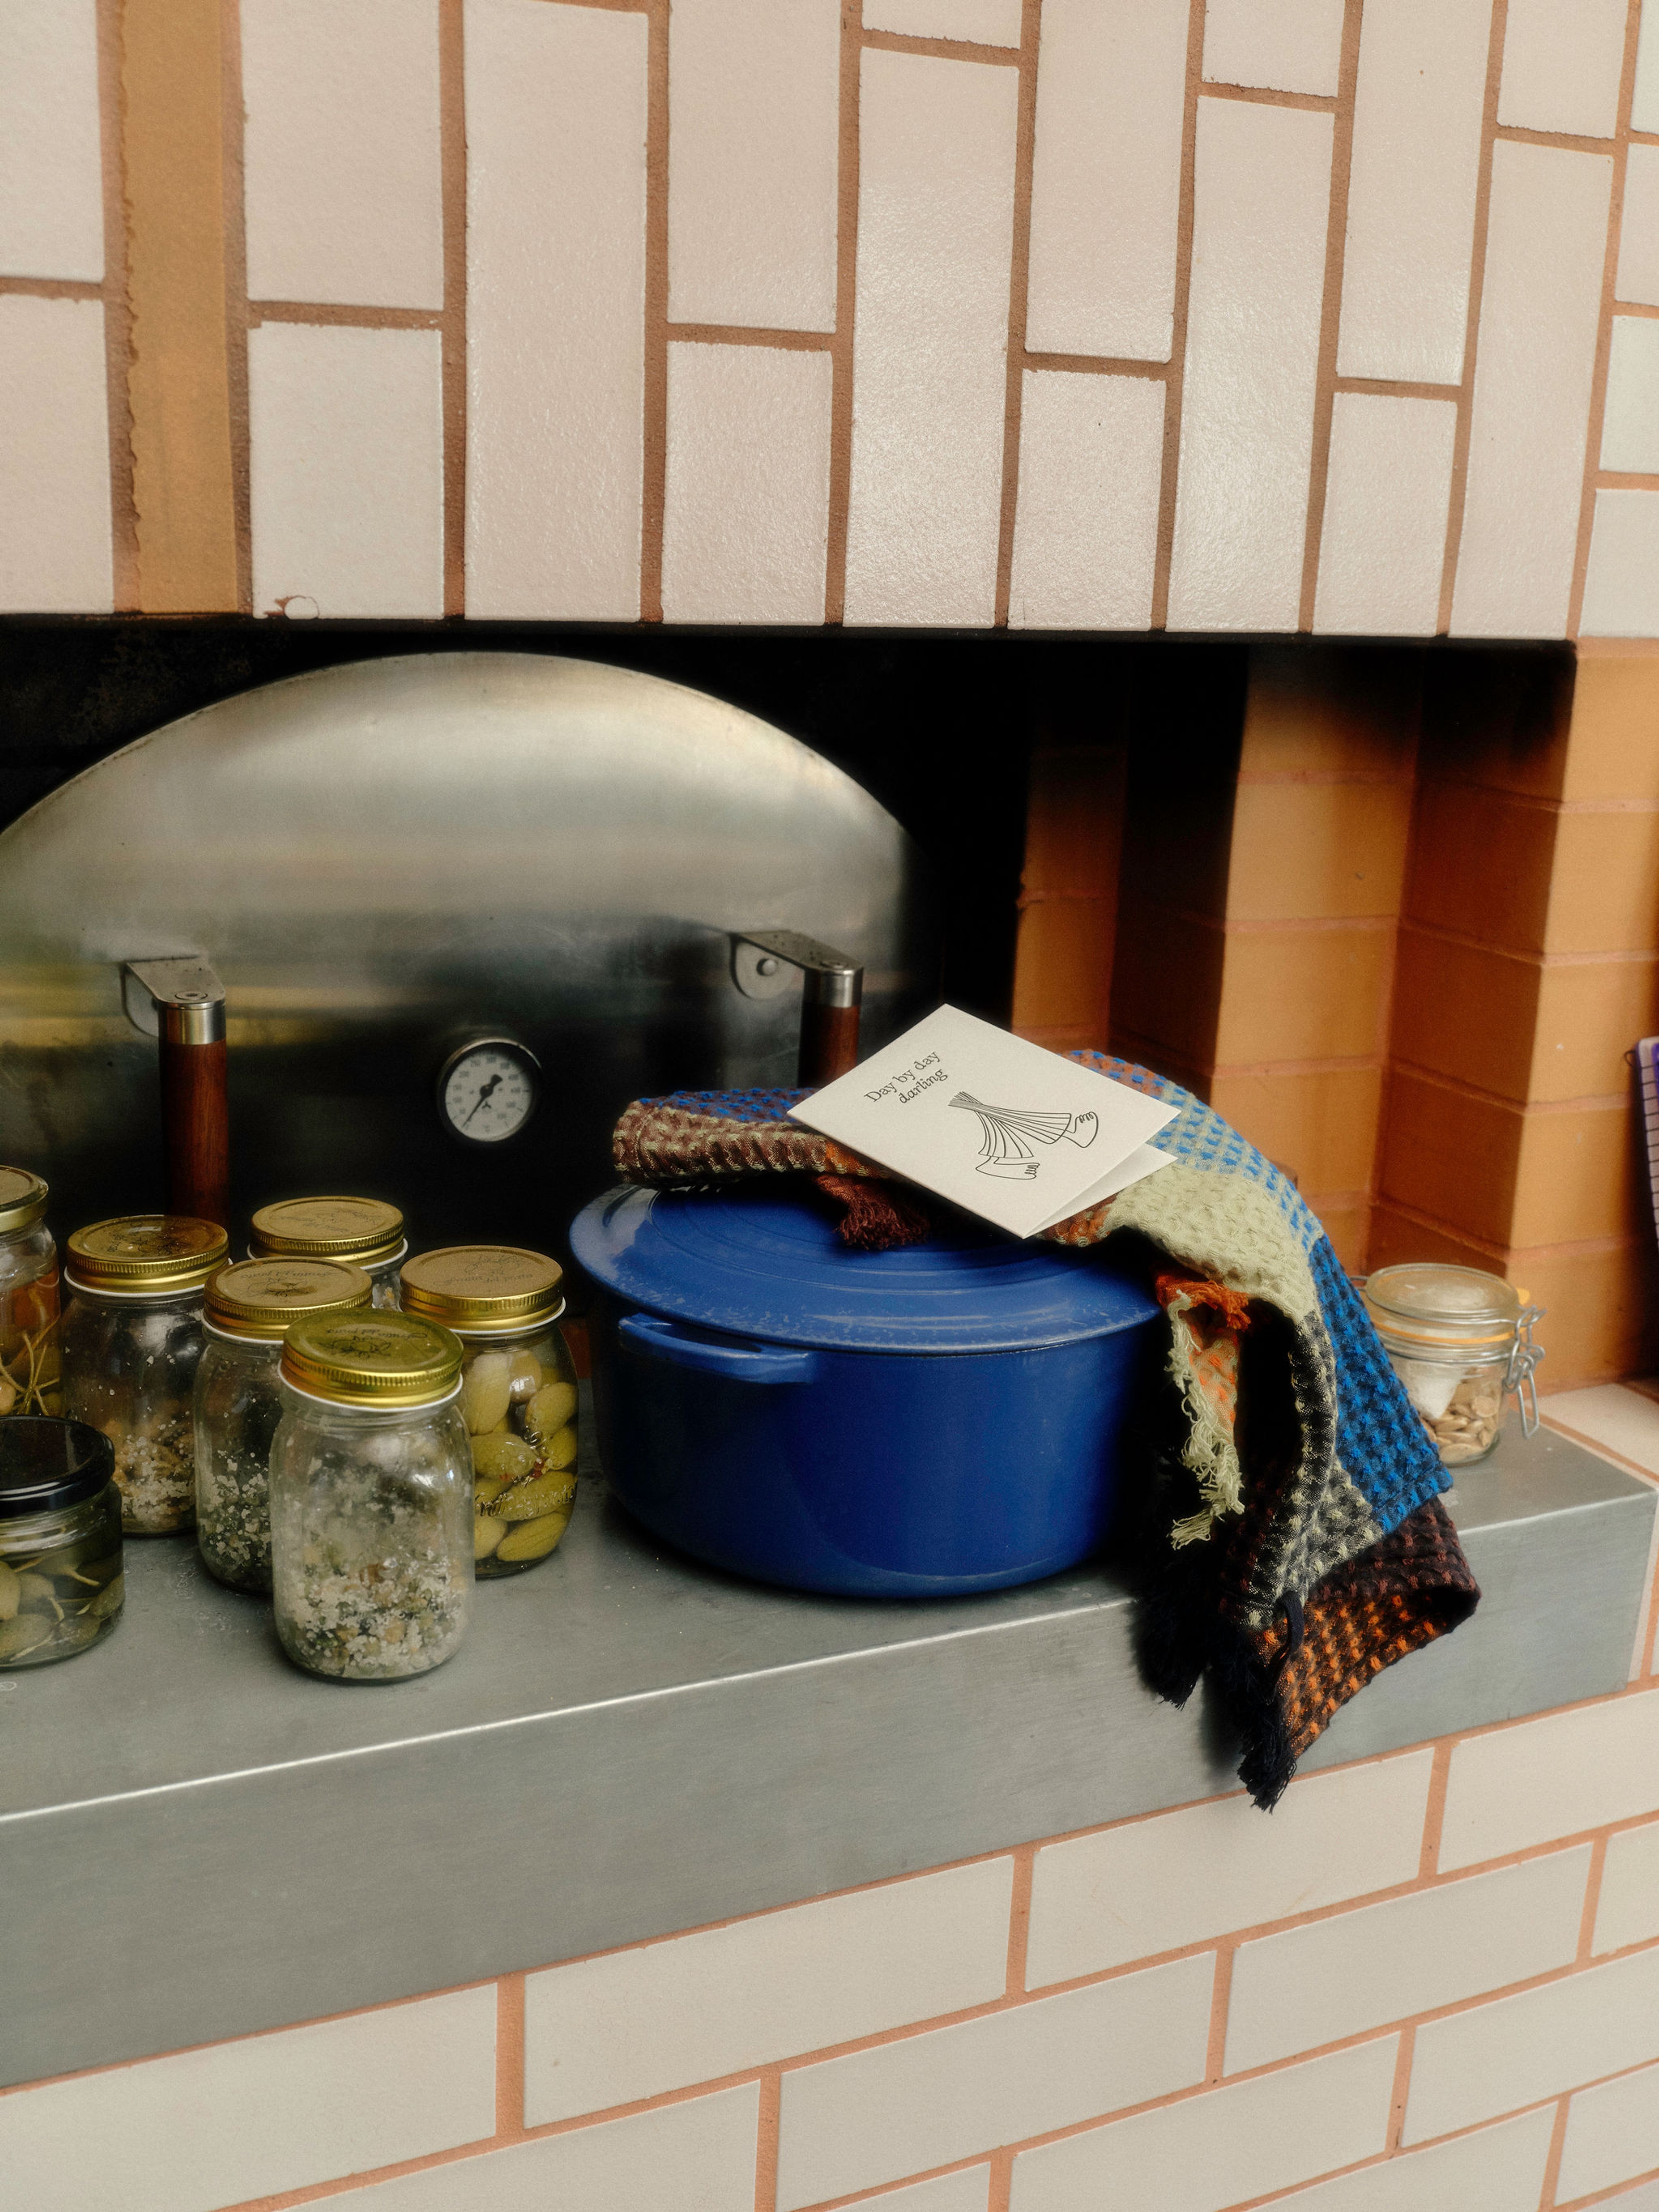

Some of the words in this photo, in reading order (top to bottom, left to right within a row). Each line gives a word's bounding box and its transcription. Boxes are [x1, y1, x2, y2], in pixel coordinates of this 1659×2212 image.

[864, 1082, 897, 1102] Day
[892, 1070, 915, 1083] by
[914, 1051, 940, 1070] day
[899, 1069, 948, 1104] darling
